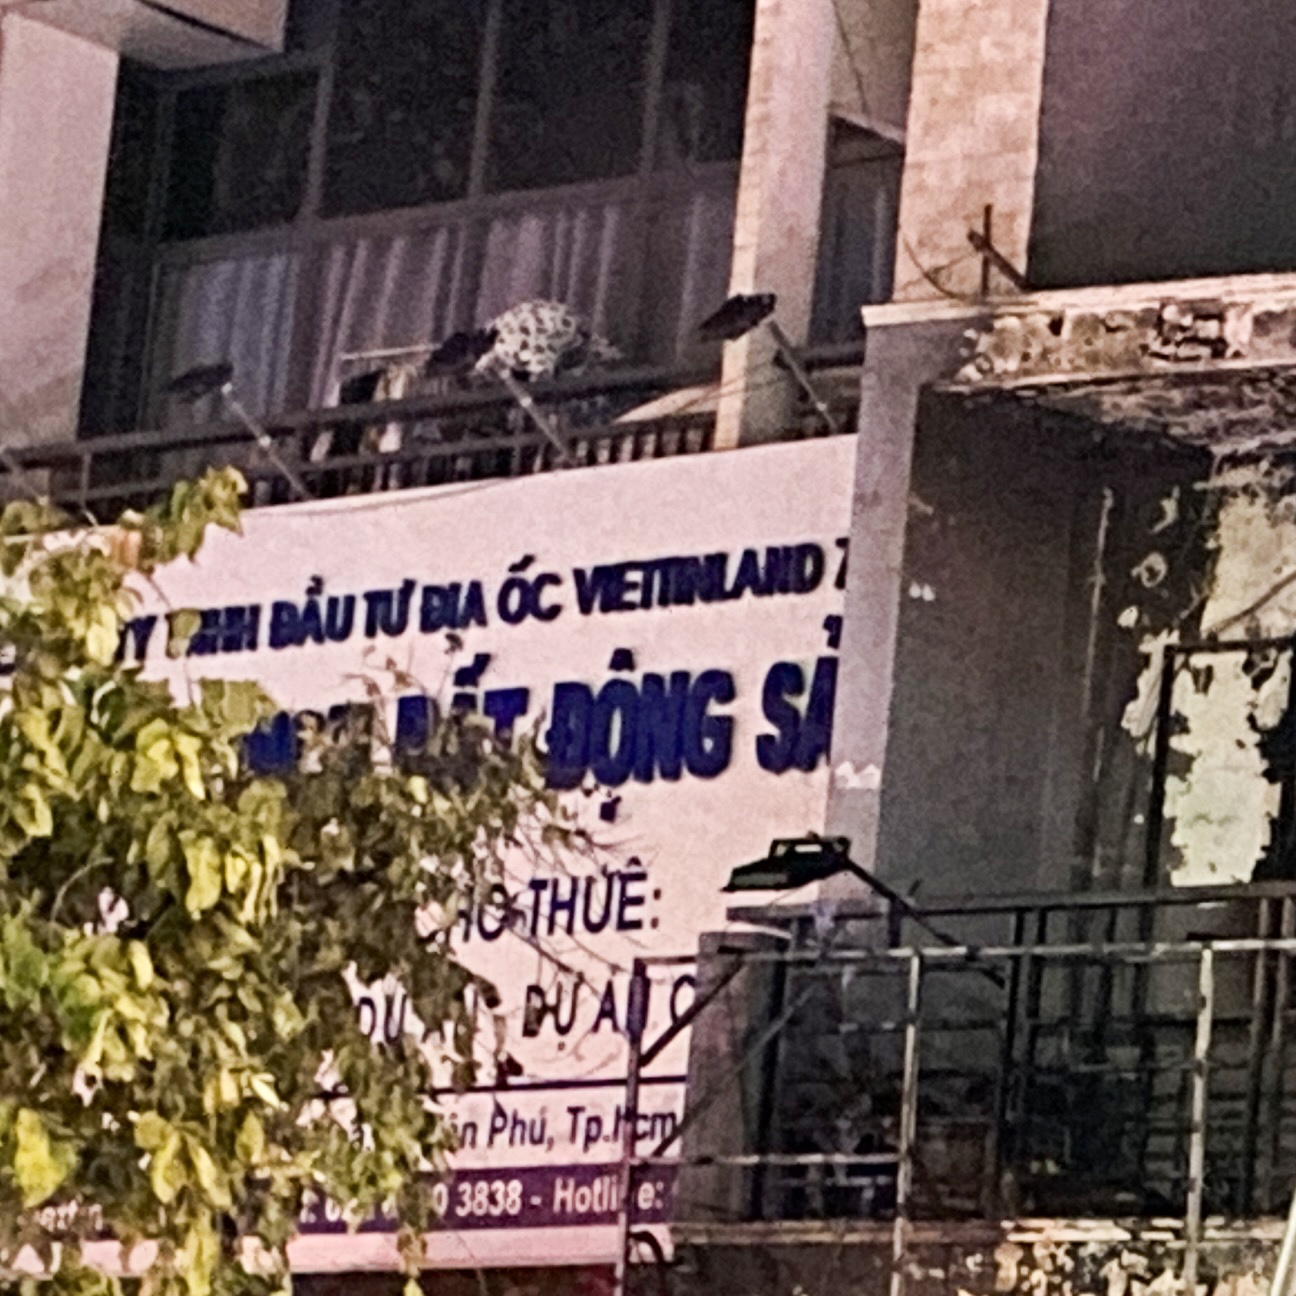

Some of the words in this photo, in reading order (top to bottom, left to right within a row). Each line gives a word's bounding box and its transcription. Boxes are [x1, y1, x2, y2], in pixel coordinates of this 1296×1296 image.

[497, 554, 562, 625] ỐC
[544, 648, 736, 823] ĐỘNG
[455, 1180, 523, 1218] 3838
[552, 1175, 664, 1215] Hotlie:
